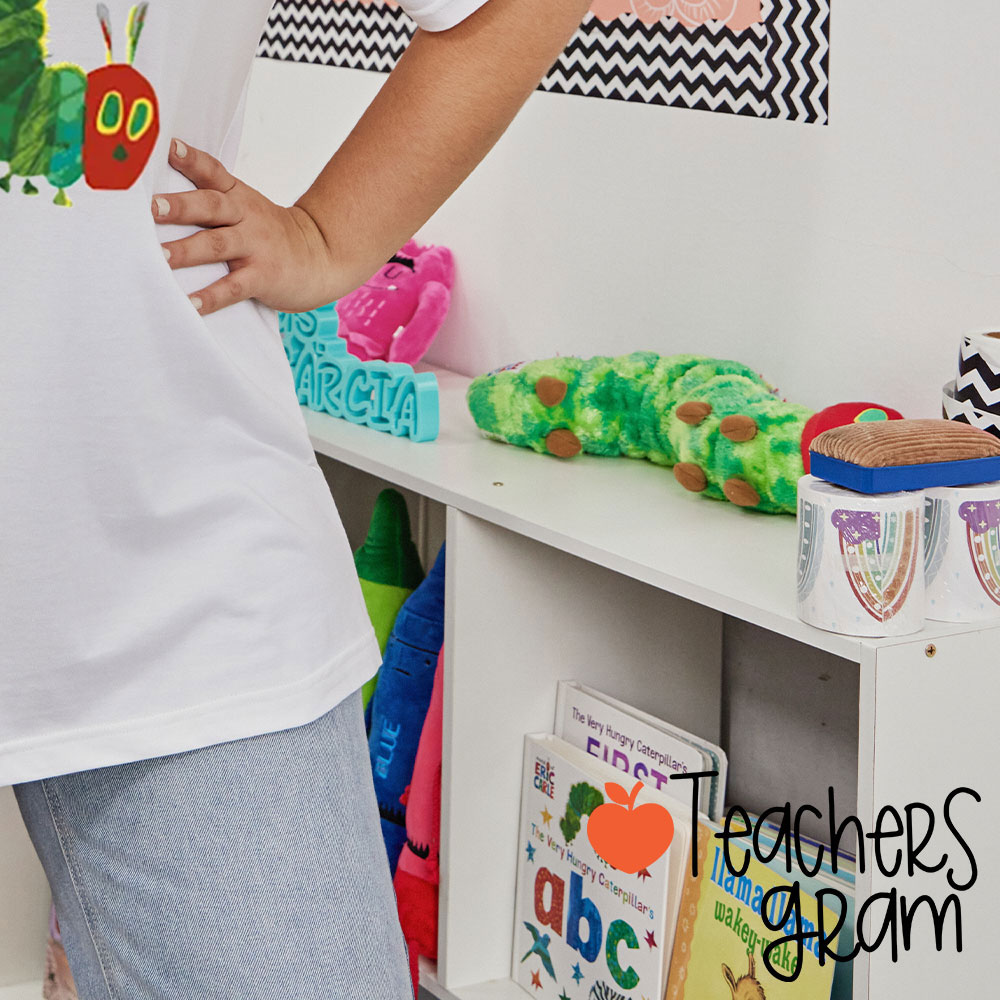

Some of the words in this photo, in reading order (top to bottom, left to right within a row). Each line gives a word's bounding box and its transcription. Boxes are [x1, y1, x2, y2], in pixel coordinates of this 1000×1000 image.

[293, 350, 420, 437] ARCIA
[571, 706, 586, 725] The
[586, 713, 605, 736] Very
[605, 725, 635, 752] Hungry
[636, 739, 689, 775] Caterpillar's
[531, 822, 545, 843] The
[546, 834, 565, 861] Very
[566, 849, 596, 884] Hungry
[598, 872, 655, 921] Caterpillar's
[534, 866, 641, 991] abc
